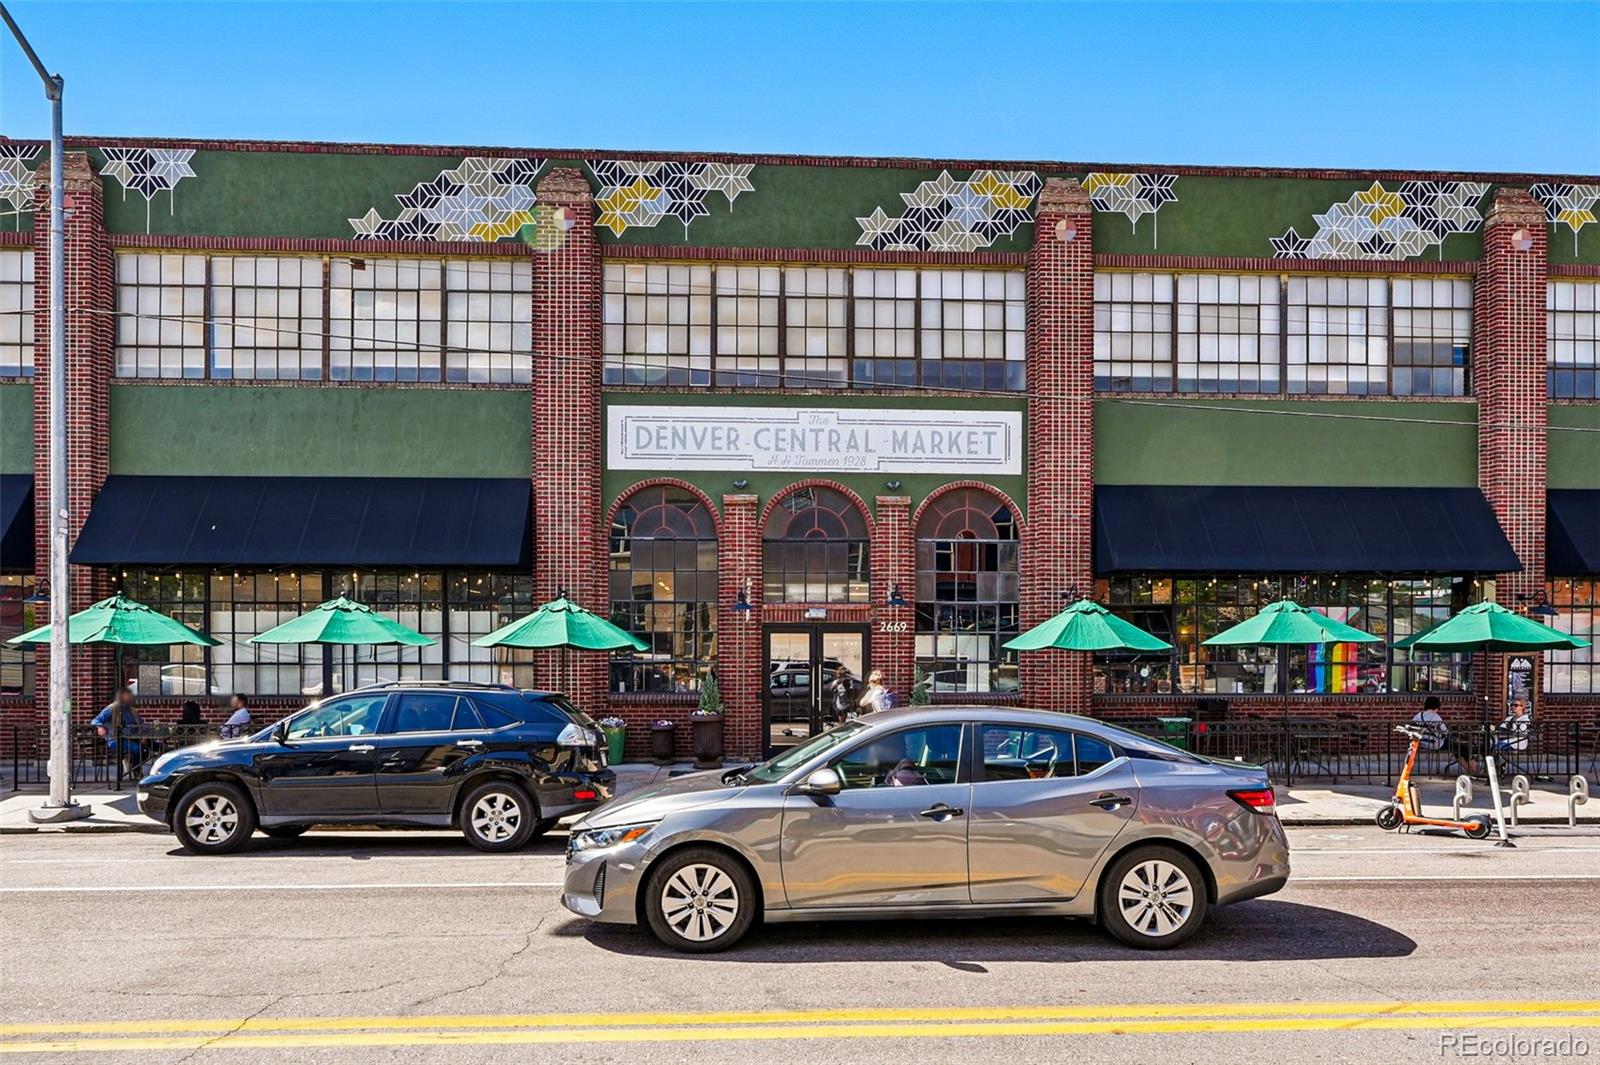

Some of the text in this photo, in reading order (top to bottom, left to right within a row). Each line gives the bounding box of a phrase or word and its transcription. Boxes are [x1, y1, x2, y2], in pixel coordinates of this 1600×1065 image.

[808, 415, 829, 425] The
[635, 425, 998, 456] DENVER CENTRAL MARKET
[795, 455, 840, 466] Tammen
[843, 456, 867, 467] 1928
[880, 621, 907, 632] 2669
